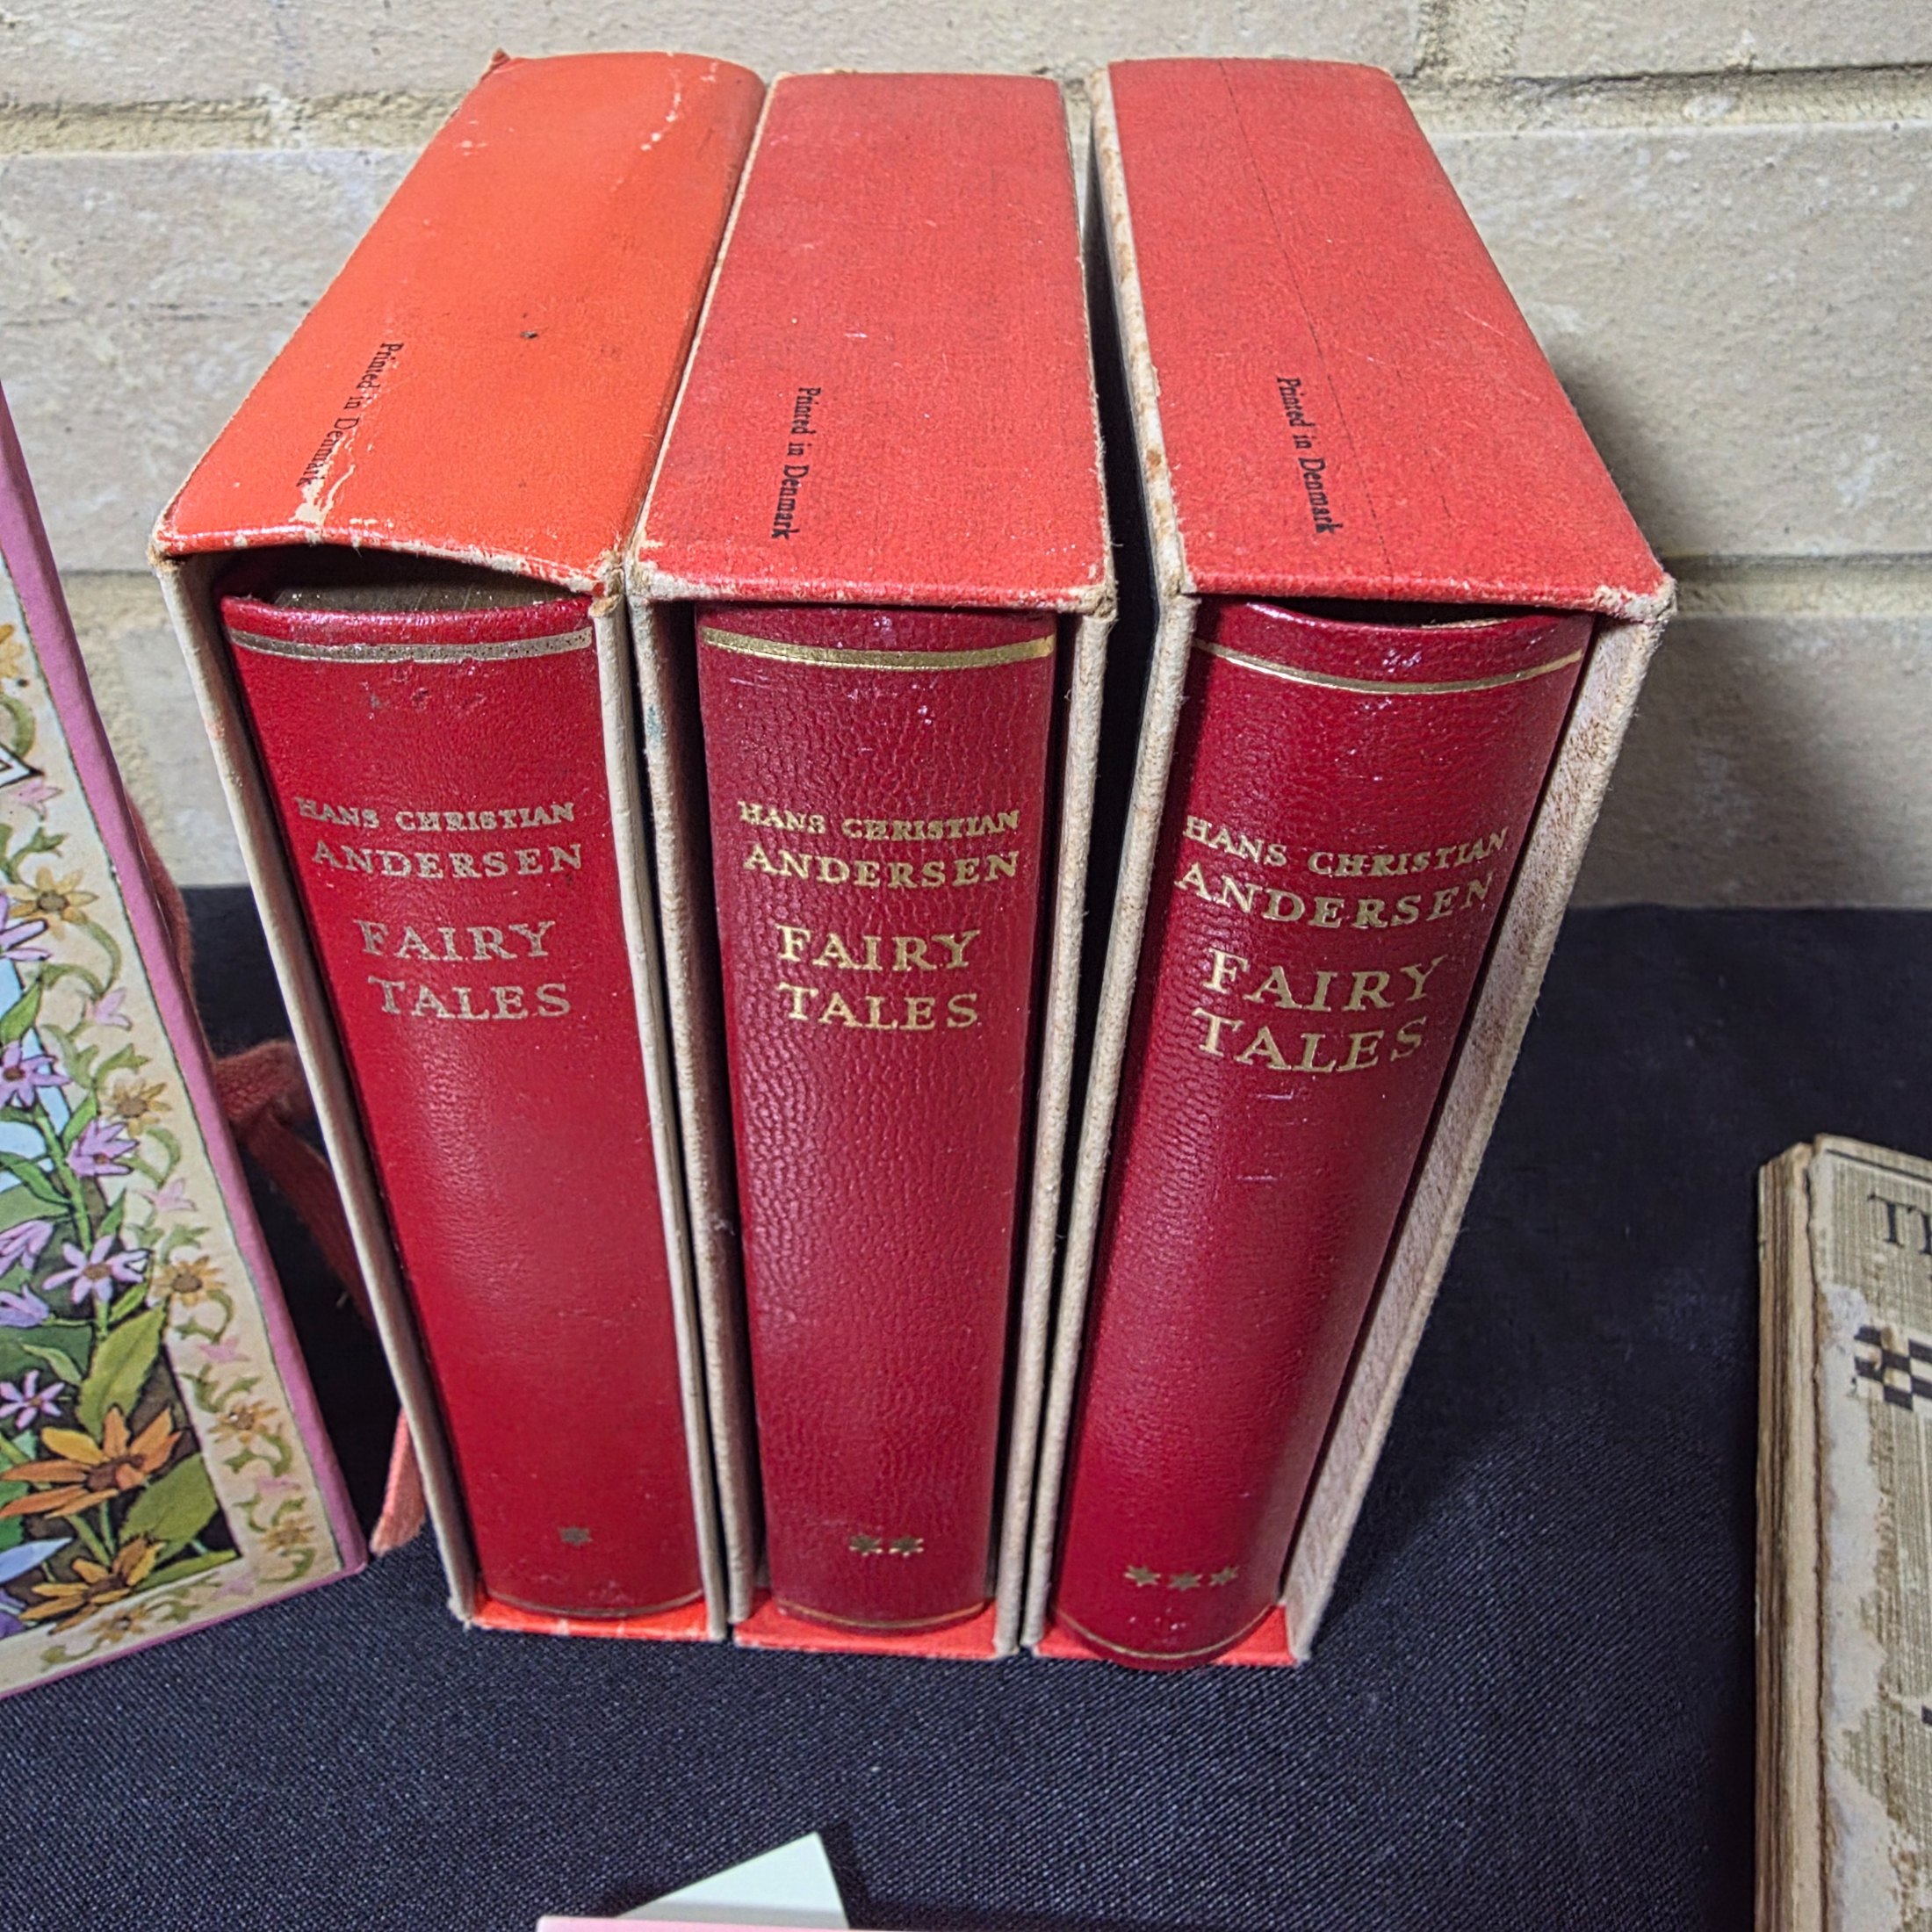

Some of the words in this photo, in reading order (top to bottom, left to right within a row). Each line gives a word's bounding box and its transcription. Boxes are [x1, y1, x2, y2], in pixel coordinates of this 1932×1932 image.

[357, 342, 405, 389] Printed
[343, 396, 372, 409] in
[790, 387, 821, 435] Printed
[1277, 377, 1316, 427] Printed
[296, 417, 360, 487] Denmark
[787, 442, 812, 456] in
[1293, 435, 1317, 449] in
[771, 465, 810, 540] Denmark
[1298, 458, 1344, 534] Denmark
[293, 797, 379, 828] HANS
[395, 802, 574, 832] CHRISTIAN
[737, 801, 825, 834] HANS
[841, 810, 1020, 841] CHRISTIAN
[311, 840, 582, 879] ANDERSEN
[742, 844, 1020, 889] ANDERSEN
[1182, 815, 1287, 867] HANS
[1308, 826, 1509, 877] CHRISTIAN
[1174, 861, 1493, 929] ANDERSEN
[354, 919, 556, 962] FAIRY
[776, 924, 981, 971] FAIRY
[367, 976, 573, 1020] TALES
[1202, 947, 1449, 1013] FAIRY
[777, 982, 979, 1031] TALES
[1191, 1006, 1427, 1073] TALES
